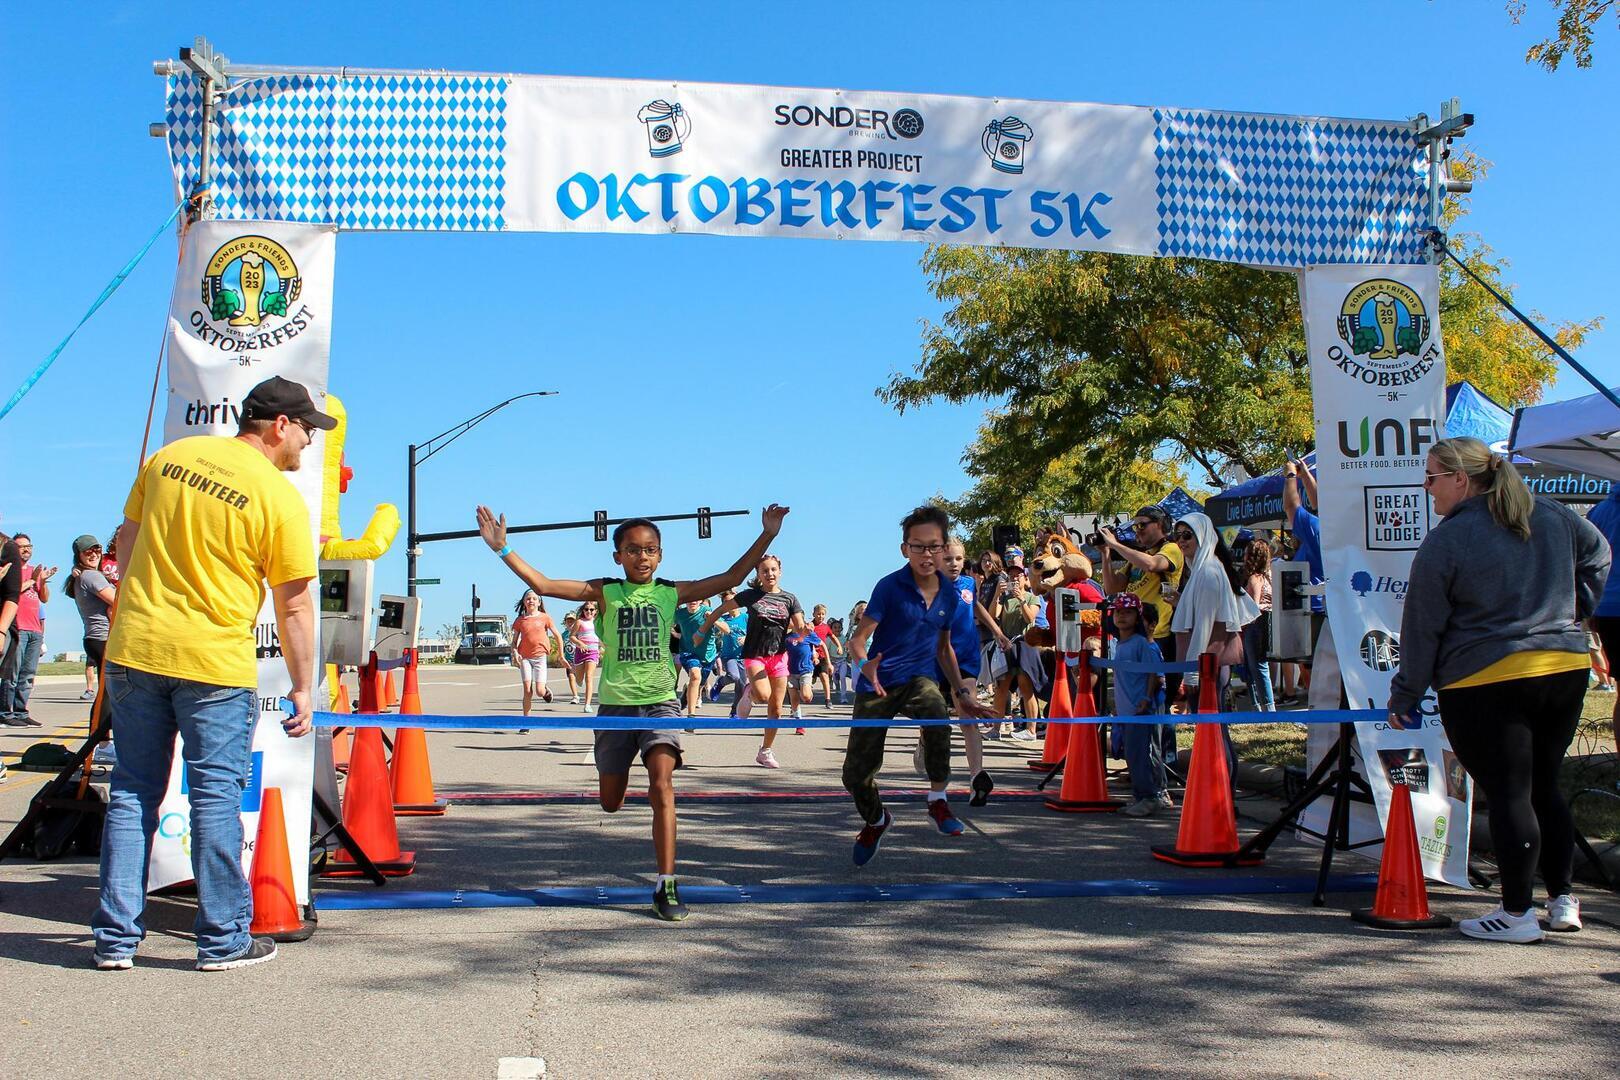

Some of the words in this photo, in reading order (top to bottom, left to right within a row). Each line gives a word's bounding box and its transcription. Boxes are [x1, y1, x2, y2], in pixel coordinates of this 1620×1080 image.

[775, 105, 897, 140] SONDER
[849, 130, 886, 139] BREWING
[781, 149, 852, 168] GREATER
[857, 150, 923, 173] PROJECT
[556, 171, 1014, 234] OKTOBERFEST
[1031, 190, 1114, 241] 5K
[214, 242, 247, 269] SONDER
[257, 242, 289, 272] FRIENDS
[1350, 285, 1376, 308] SONDER
[1386, 284, 1418, 308] FRIENDS
[190, 304, 315, 353] OKTOBERFEST
[239, 356, 251, 366] 5K
[1327, 343, 1440, 387] OKTOBERFEST
[1387, 392, 1399, 402] 5K
[1341, 461, 1368, 469] BETTER
[1370, 460, 1391, 468] FOOD.
[1393, 459, 1419, 468] BETTER
[161, 462, 249, 511] VOLUNTEER
[1523, 473, 1611, 494] triathlon
[1226, 502, 1240, 520] Live
[1241, 496, 1254, 518] Life
[1255, 498, 1262, 517] in
[1374, 494, 1420, 509] GREAT
[1375, 527, 1421, 542] LODGE
[618, 607, 659, 628] BIG
[617, 629, 659, 647] TIME
[618, 648, 660, 662] BALLER
